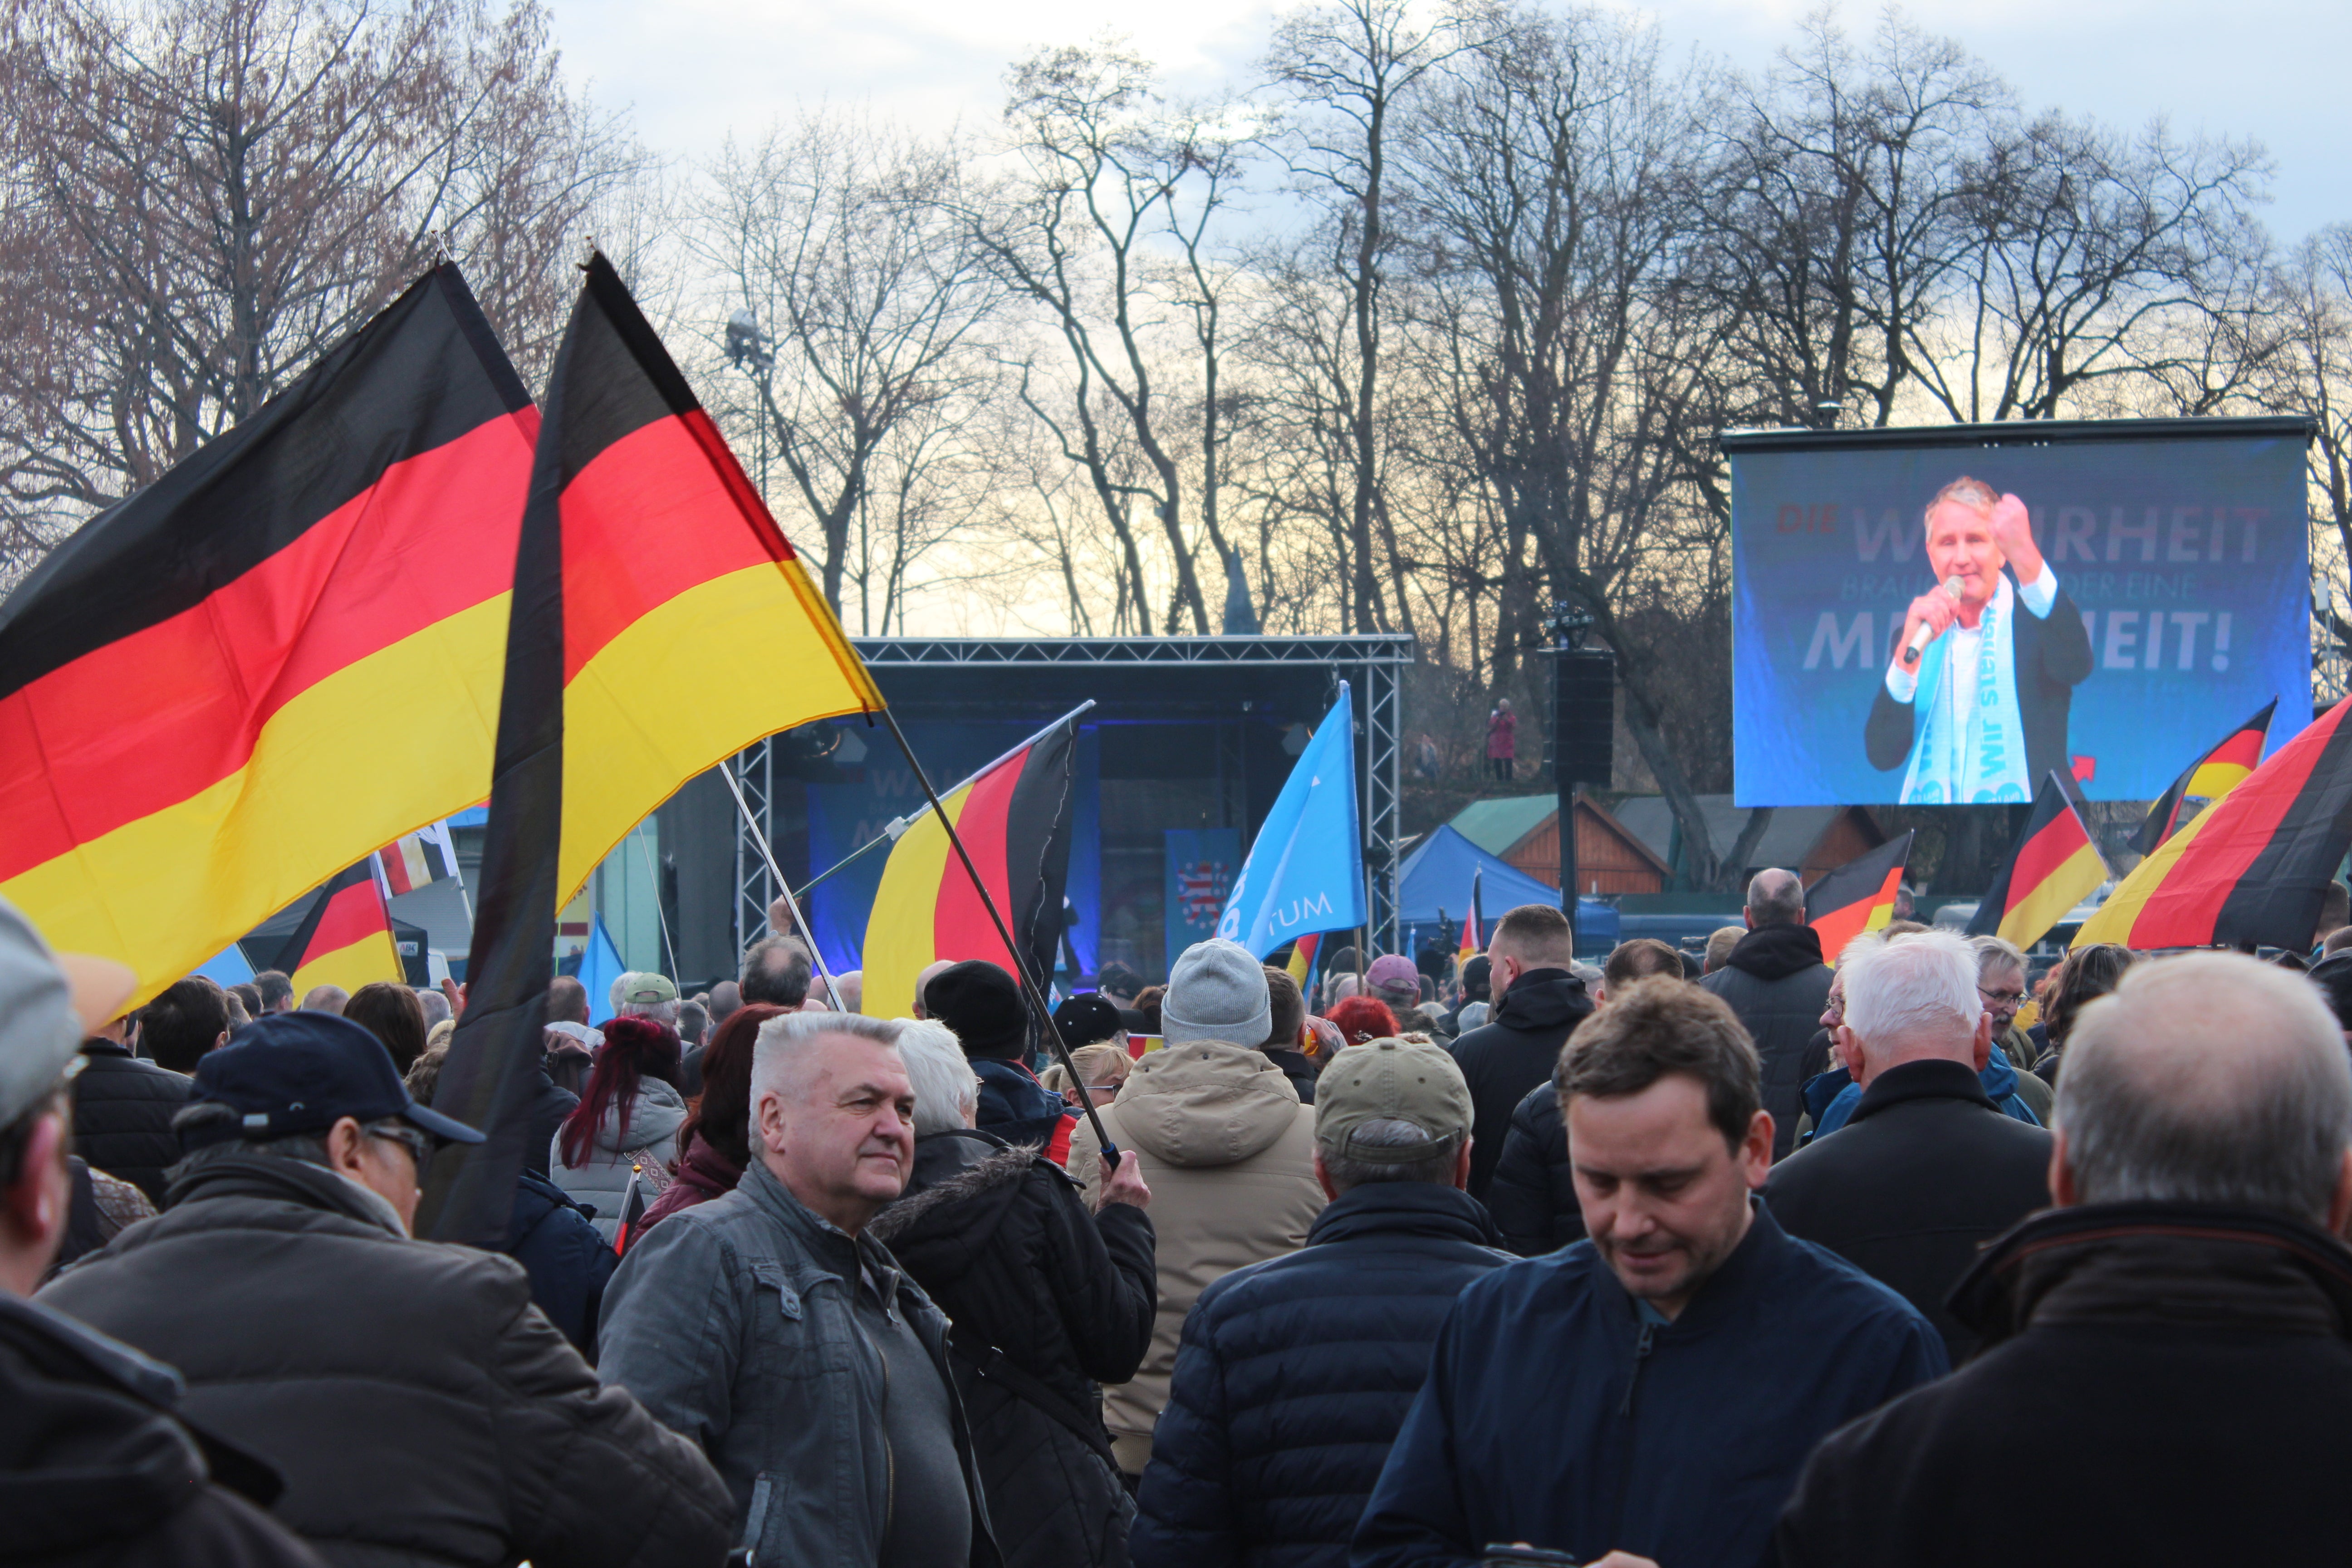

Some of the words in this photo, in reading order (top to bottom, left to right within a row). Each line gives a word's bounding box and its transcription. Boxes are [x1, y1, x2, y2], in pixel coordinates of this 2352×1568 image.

[1776, 503, 1838, 534] DIE
[2127, 571, 2199, 600] EINE
[1980, 718, 2007, 779] Wir
